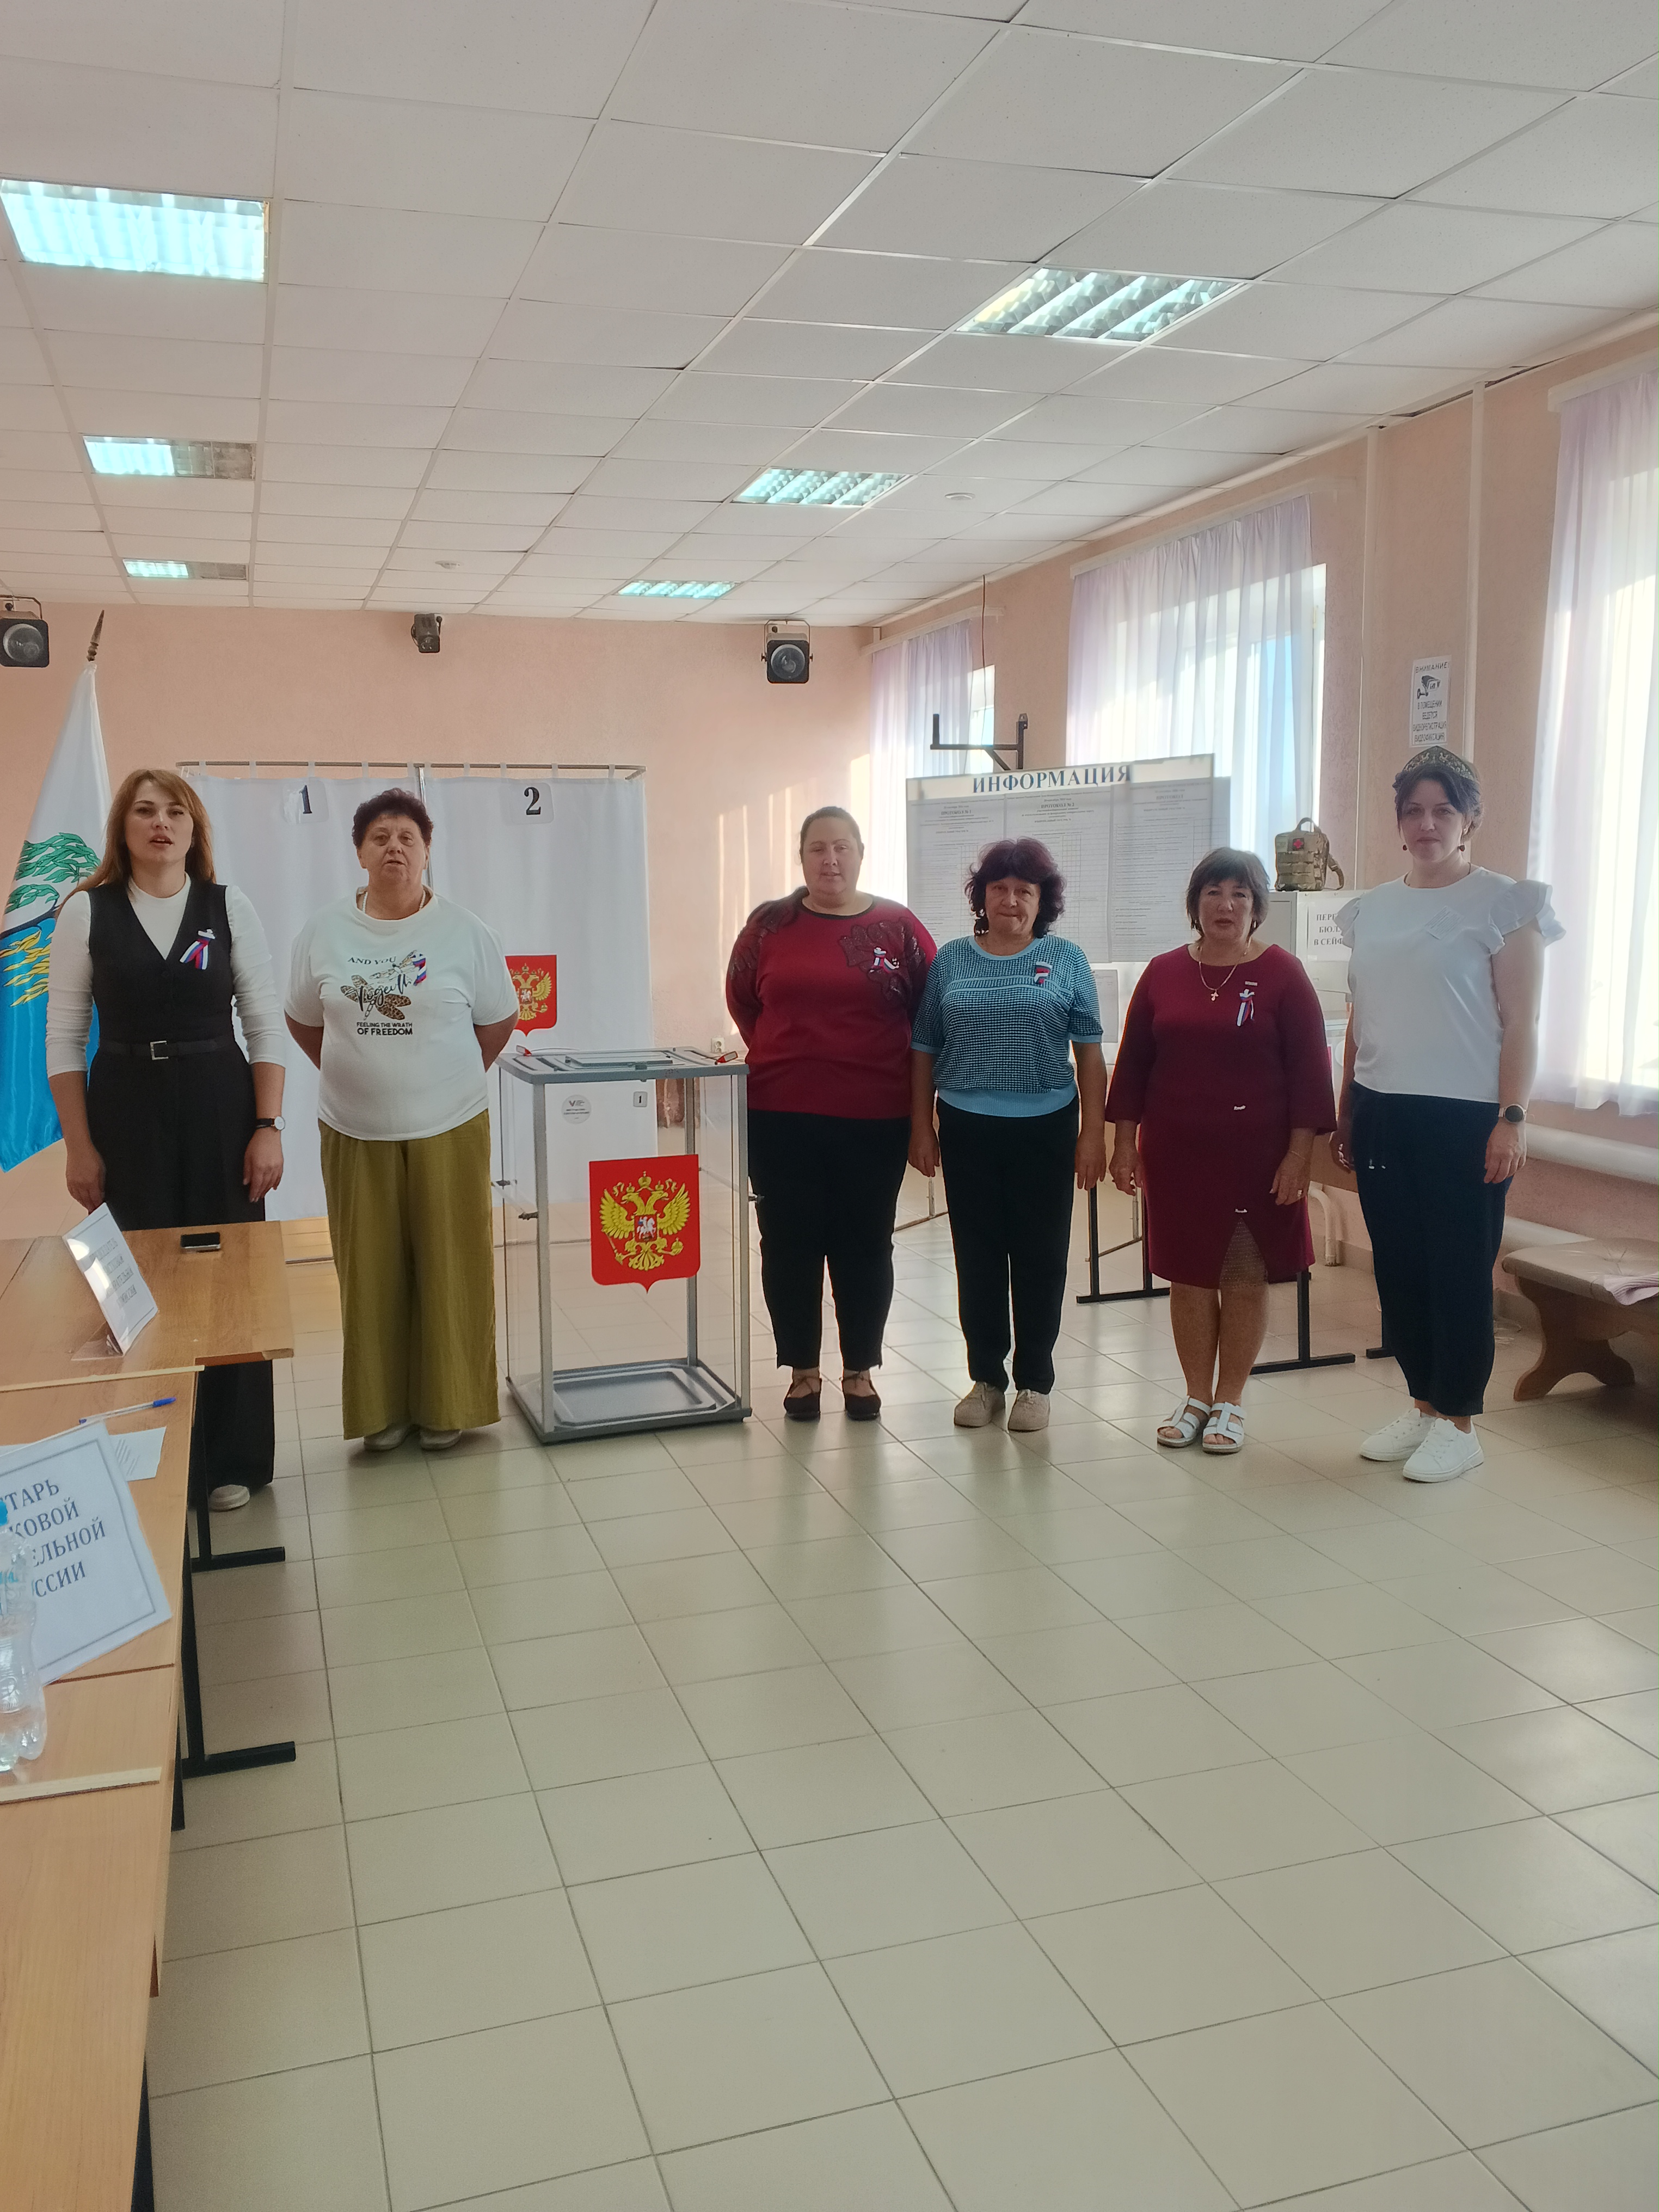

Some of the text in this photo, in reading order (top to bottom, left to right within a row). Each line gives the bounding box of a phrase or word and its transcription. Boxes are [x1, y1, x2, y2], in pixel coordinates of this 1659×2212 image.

[973, 764, 1131, 793] ИНФОРМАЦИЯ
[299, 785, 312, 814] 1
[524, 787, 541, 815] 2
[374, 956, 396, 964] YOU
[638, 1095, 642, 1103] 1
[0, 1479, 59, 1511] ТАРЬ
[31, 1561, 86, 1597] ССИИ
